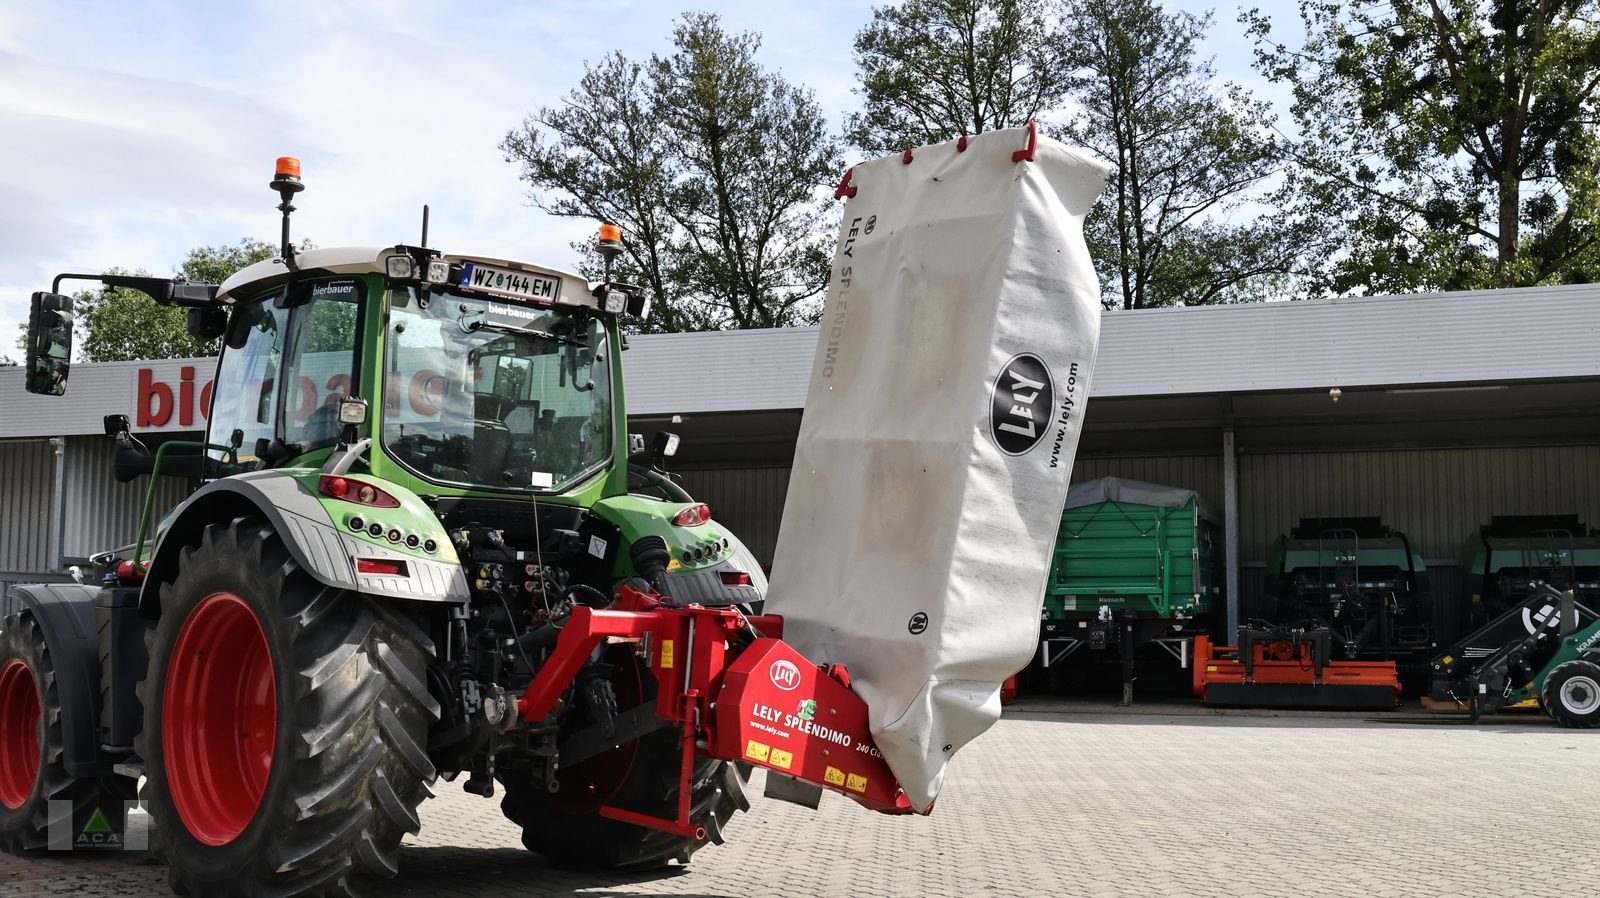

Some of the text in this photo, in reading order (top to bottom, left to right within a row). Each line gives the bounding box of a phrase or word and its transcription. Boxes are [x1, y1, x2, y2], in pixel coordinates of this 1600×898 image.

[312, 281, 354, 296] bierbauer
[474, 268, 552, 298] WZ 144 EM
[822, 217, 862, 378] LELY SPLENDIMO
[488, 300, 536, 320] bierbauer
[997, 369, 1045, 439] LELY
[1049, 362, 1079, 469] www.lely.com
[774, 663, 796, 687] LELY
[750, 720, 790, 739] www.lely.com
[752, 703, 781, 723] LELY
[784, 714, 851, 747] SPLENDIMO
[855, 742, 870, 754] 240
